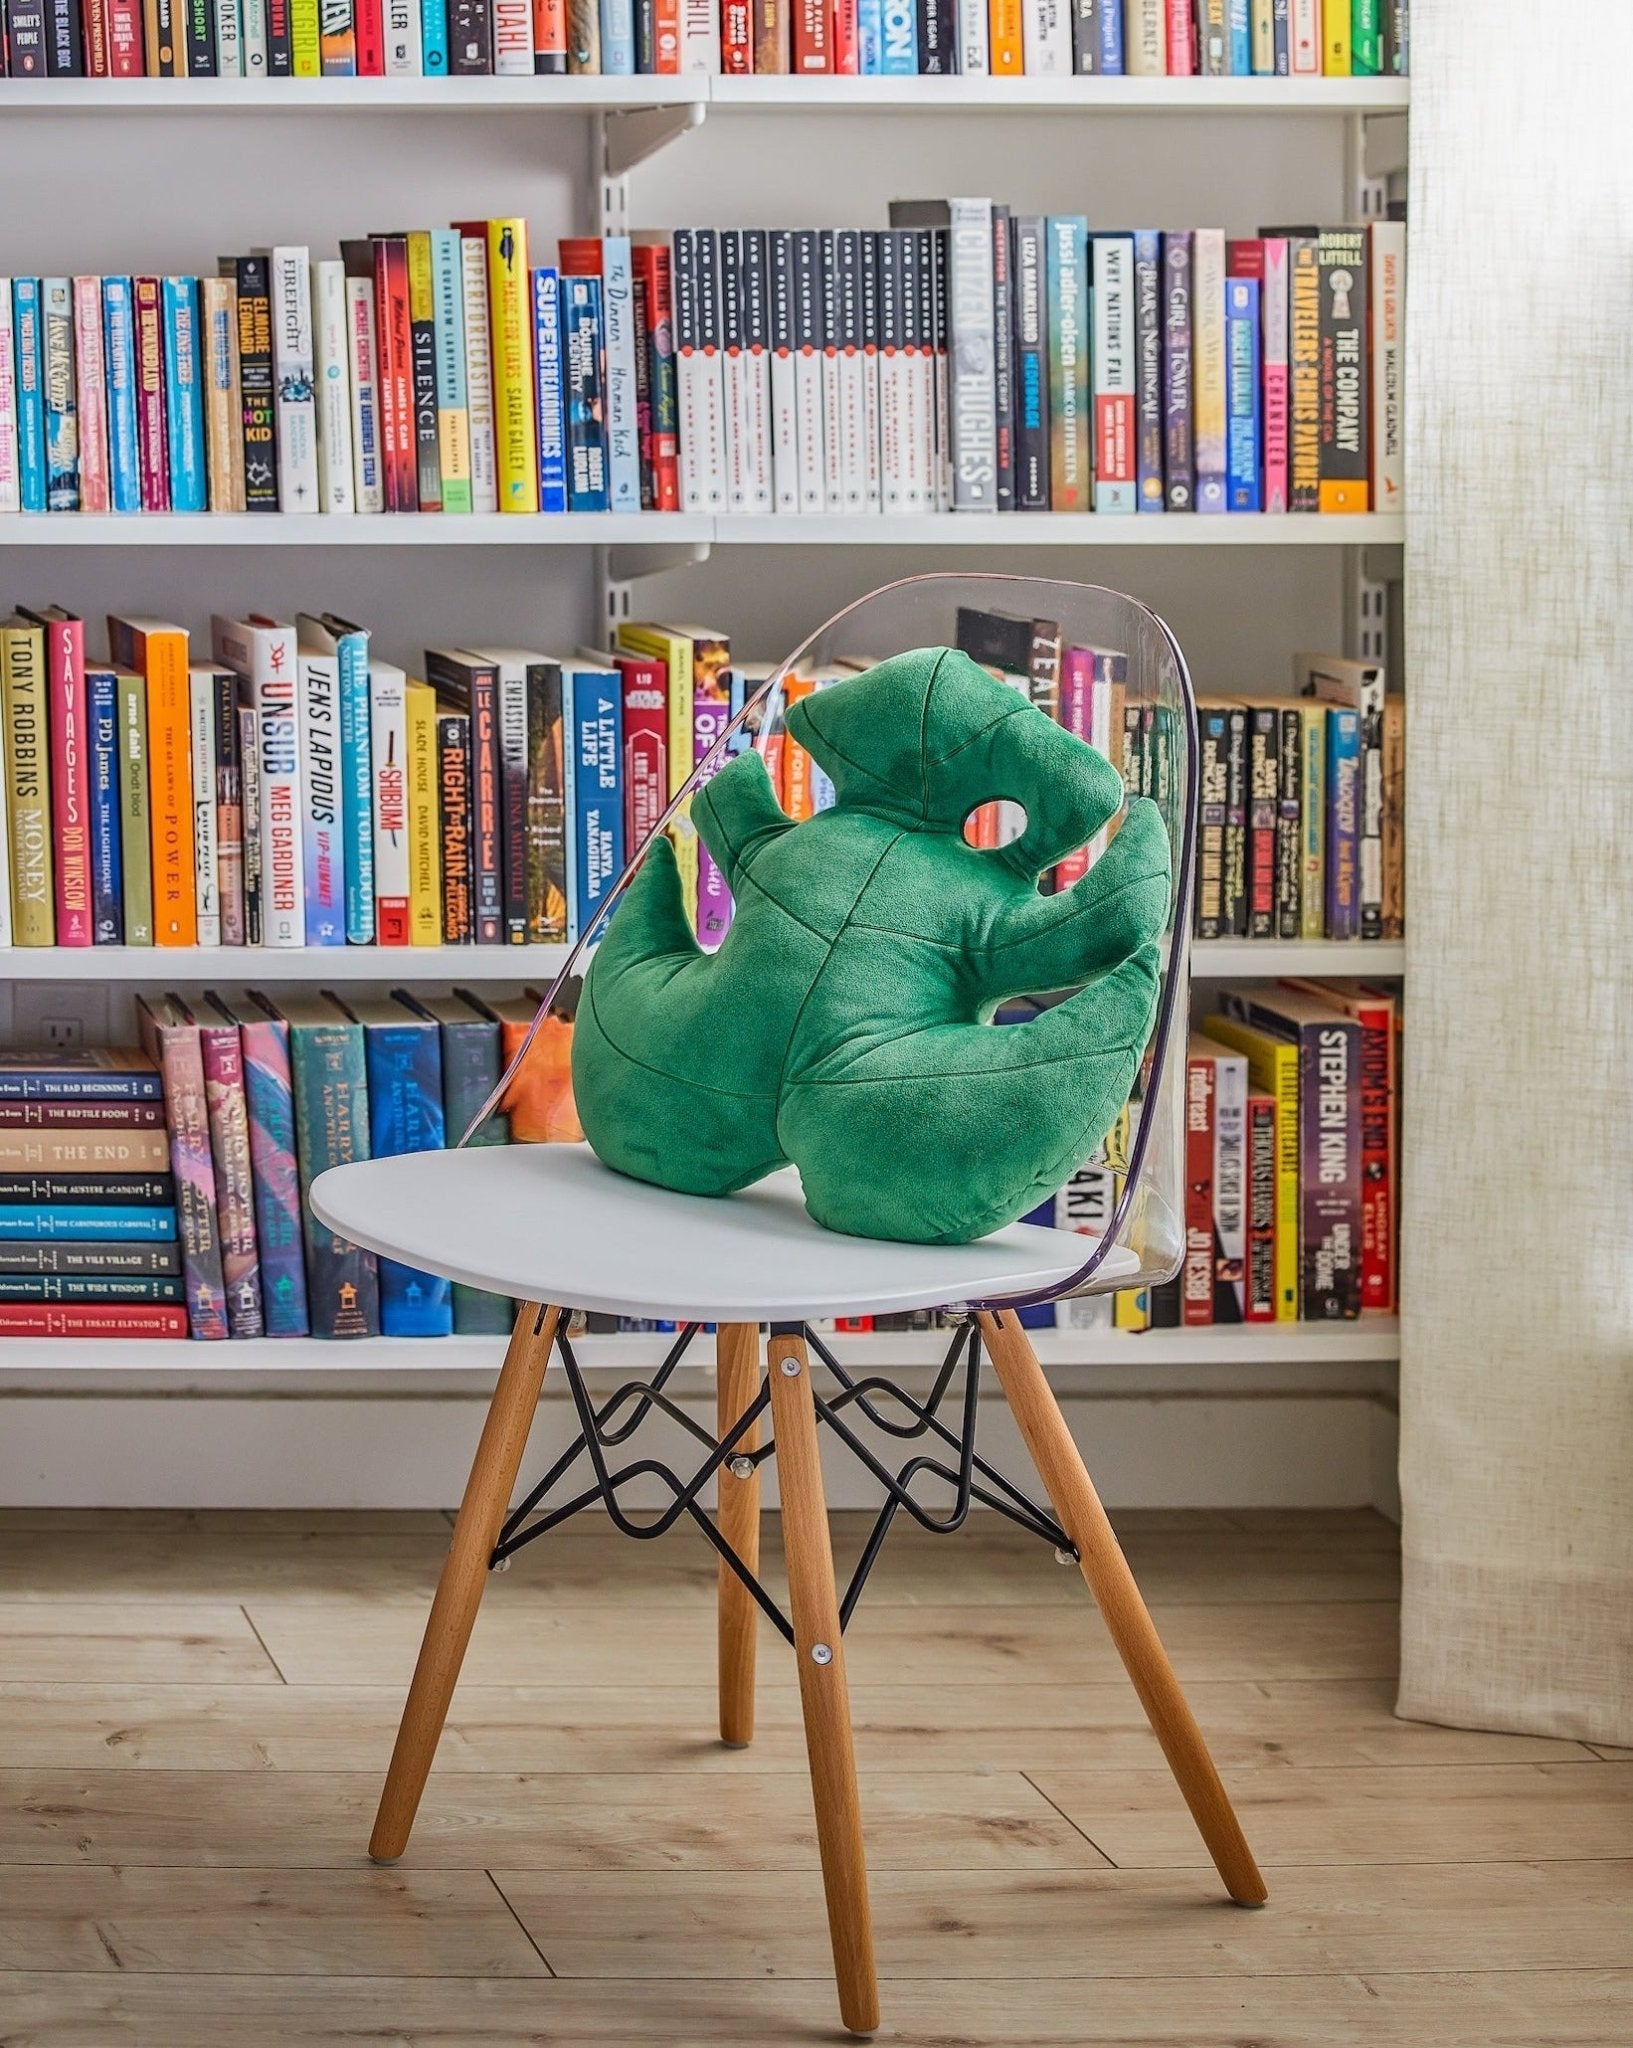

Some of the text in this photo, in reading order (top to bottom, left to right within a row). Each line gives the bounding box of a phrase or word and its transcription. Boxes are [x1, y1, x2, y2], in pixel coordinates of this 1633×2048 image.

[16, 31, 39, 46] PEOPLE
[56, 17, 72, 69] BLACK BOX
[193, 0, 206, 42] SHORT
[496, 4, 528, 56] DAHL
[927, 19, 938, 50] EGAN
[1054, 222, 1079, 265] jussi
[1105, 249, 1121, 283] WHY
[1319, 233, 1363, 249] ROBERT
[1319, 250, 1363, 266] LITTELL
[283, 259, 300, 353] FIREFIGHT
[679, 237, 692, 339] IAN FLEMING
[801, 237, 813, 339] IAN FLEMING
[1022, 236, 1040, 343] LIZA MARKLUND
[1059, 267, 1080, 367] adler-olsen
[1140, 270, 1157, 315] BEAR
[1169, 287, 1187, 328] GIRL
[239, 298, 255, 354] LEONARD
[254, 297, 271, 353] ELMORE
[441, 240, 457, 400] THE QUANTUM LABYRINTH
[464, 242, 490, 425] SUPERFORECASTING
[579, 316, 594, 377] BOURNE
[995, 219, 1010, 469] INCEPTION THE SHOOTING SCRIPT NOLAN
[1106, 292, 1122, 351] NATIONS
[501, 280, 525, 472] MAGIC FOR LIARS SARAH GAILEY
[536, 276, 562, 458] SUPERFREAKONOMICS
[569, 331, 584, 392] IDENTITY
[607, 265, 632, 459] The Dinner Herman Koch
[956, 230, 994, 483] CITIZEN HUGHES
[1107, 358, 1123, 387] FAIL
[1141, 330, 1160, 423] NIGHTINGALE
[1168, 349, 1189, 414] TOWER
[1293, 265, 1319, 490] TRAVELERS CHRIS PAVONE
[246, 397, 268, 407] THE
[381, 377, 393, 410] JAMES
[397, 375, 408, 409] JAMES
[415, 332, 436, 442] SILENCE
[1063, 370, 1076, 416] MARCO
[1335, 328, 1359, 453] THE COMPANY
[1384, 348, 1398, 457] MALCOLM GLADWELL
[243, 410, 271, 425] HOT
[246, 427, 272, 442] KID
[385, 425, 395, 451] CAIN
[399, 425, 409, 450] CAIN
[1268, 374, 1285, 467] CHANDLER
[572, 446, 589, 494] LUDLUM
[588, 446, 604, 492] ROBERT
[11, 637, 38, 798] TONY ROBBINS
[222, 680, 232, 755] PALAHNIUK
[342, 645, 354, 744] NORTON JUSTER
[478, 691, 492, 709] LE
[128, 692, 143, 817] arne dahl Ondt blod
[165, 726, 174, 748] THE
[581, 720, 598, 767] LIFE
[598, 697, 616, 788] A LITTLE
[791, 749, 804, 781] FOR
[61, 628, 85, 911] SAVAGES DON WINSLOW
[166, 763, 175, 791] LAWS
[261, 681, 296, 912] UNSUB MEG GARDINER
[308, 665, 335, 909] JENS LAPIDUS VIP-RUMMET
[352, 645, 373, 931] THE PHANTOM TOLLBOOTH
[379, 769, 404, 830] SHIBUMI
[505, 680, 525, 903] EMBASSYTOWN CHINA MIÉVILLE
[95, 717, 113, 896] PD James THE LIGHTHOUSE
[167, 794, 175, 808] OF
[415, 719, 431, 893] SLADE HOUSE DAVID MITCHELL
[443, 747, 467, 877] RIGHT RAIN
[23, 808, 47, 905] MONEY
[164, 815, 180, 902] POWER
[201, 810, 213, 880] DAVID PEACE
[586, 809, 600, 899] YANAGIHARA
[600, 830, 613, 878] HANYA
[445, 878, 458, 939] PELECANOS
[457, 884, 467, 922] GEORGE
[44, 1083, 129, 1093] THE BAD BEGINNING
[48, 1110, 129, 1119] THE REPTILE ROOM
[1188, 1066, 1212, 1132] redbreast
[1318, 1029, 1348, 1183] STEPHEN KING
[1363, 1029, 1389, 1151] AXIOM'S END
[335, 1083, 353, 1161] HARRY
[1252, 1124, 1274, 1179] THOMAS
[53, 1146, 129, 1160] THE END
[1253, 1180, 1274, 1228] HARRIS
[1364, 1202, 1376, 1250] ELLIS
[1375, 1191, 1388, 1261] LINDSAY
[66, 1255, 142, 1265] THE VILE VILLAGE
[1187, 1227, 1211, 1248] JO
[1334, 1222, 1350, 1270] UNDER
[67, 1283, 147, 1292] THE WIDE WINDOW
[1315, 1249, 1334, 1291] DOME
[67, 1319, 83, 1329] THE
[118, 1319, 160, 1329] ELEVATOR
